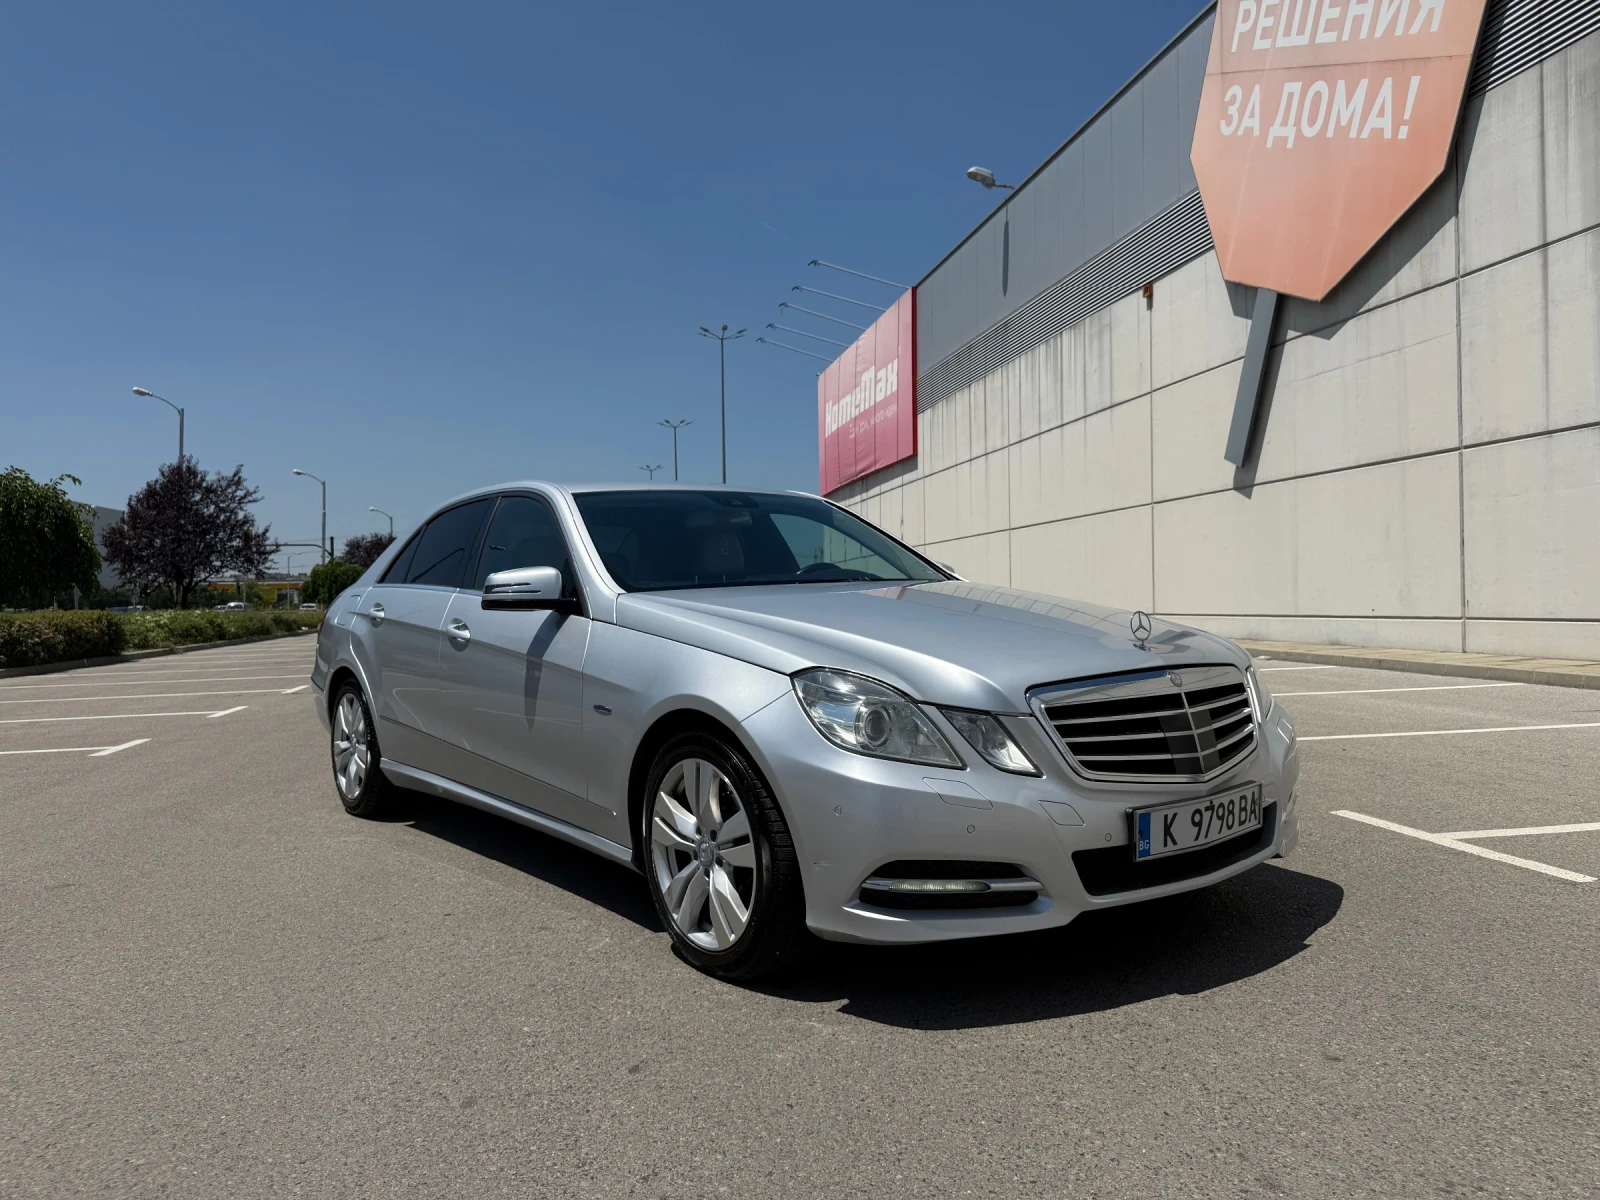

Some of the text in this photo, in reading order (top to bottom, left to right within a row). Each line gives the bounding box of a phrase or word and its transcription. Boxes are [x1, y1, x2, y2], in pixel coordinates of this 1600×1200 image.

[1220, 75, 1421, 149] ЗА ДОМА!
[1139, 839, 1150, 851] BG
[1163, 812, 1178, 848] K
